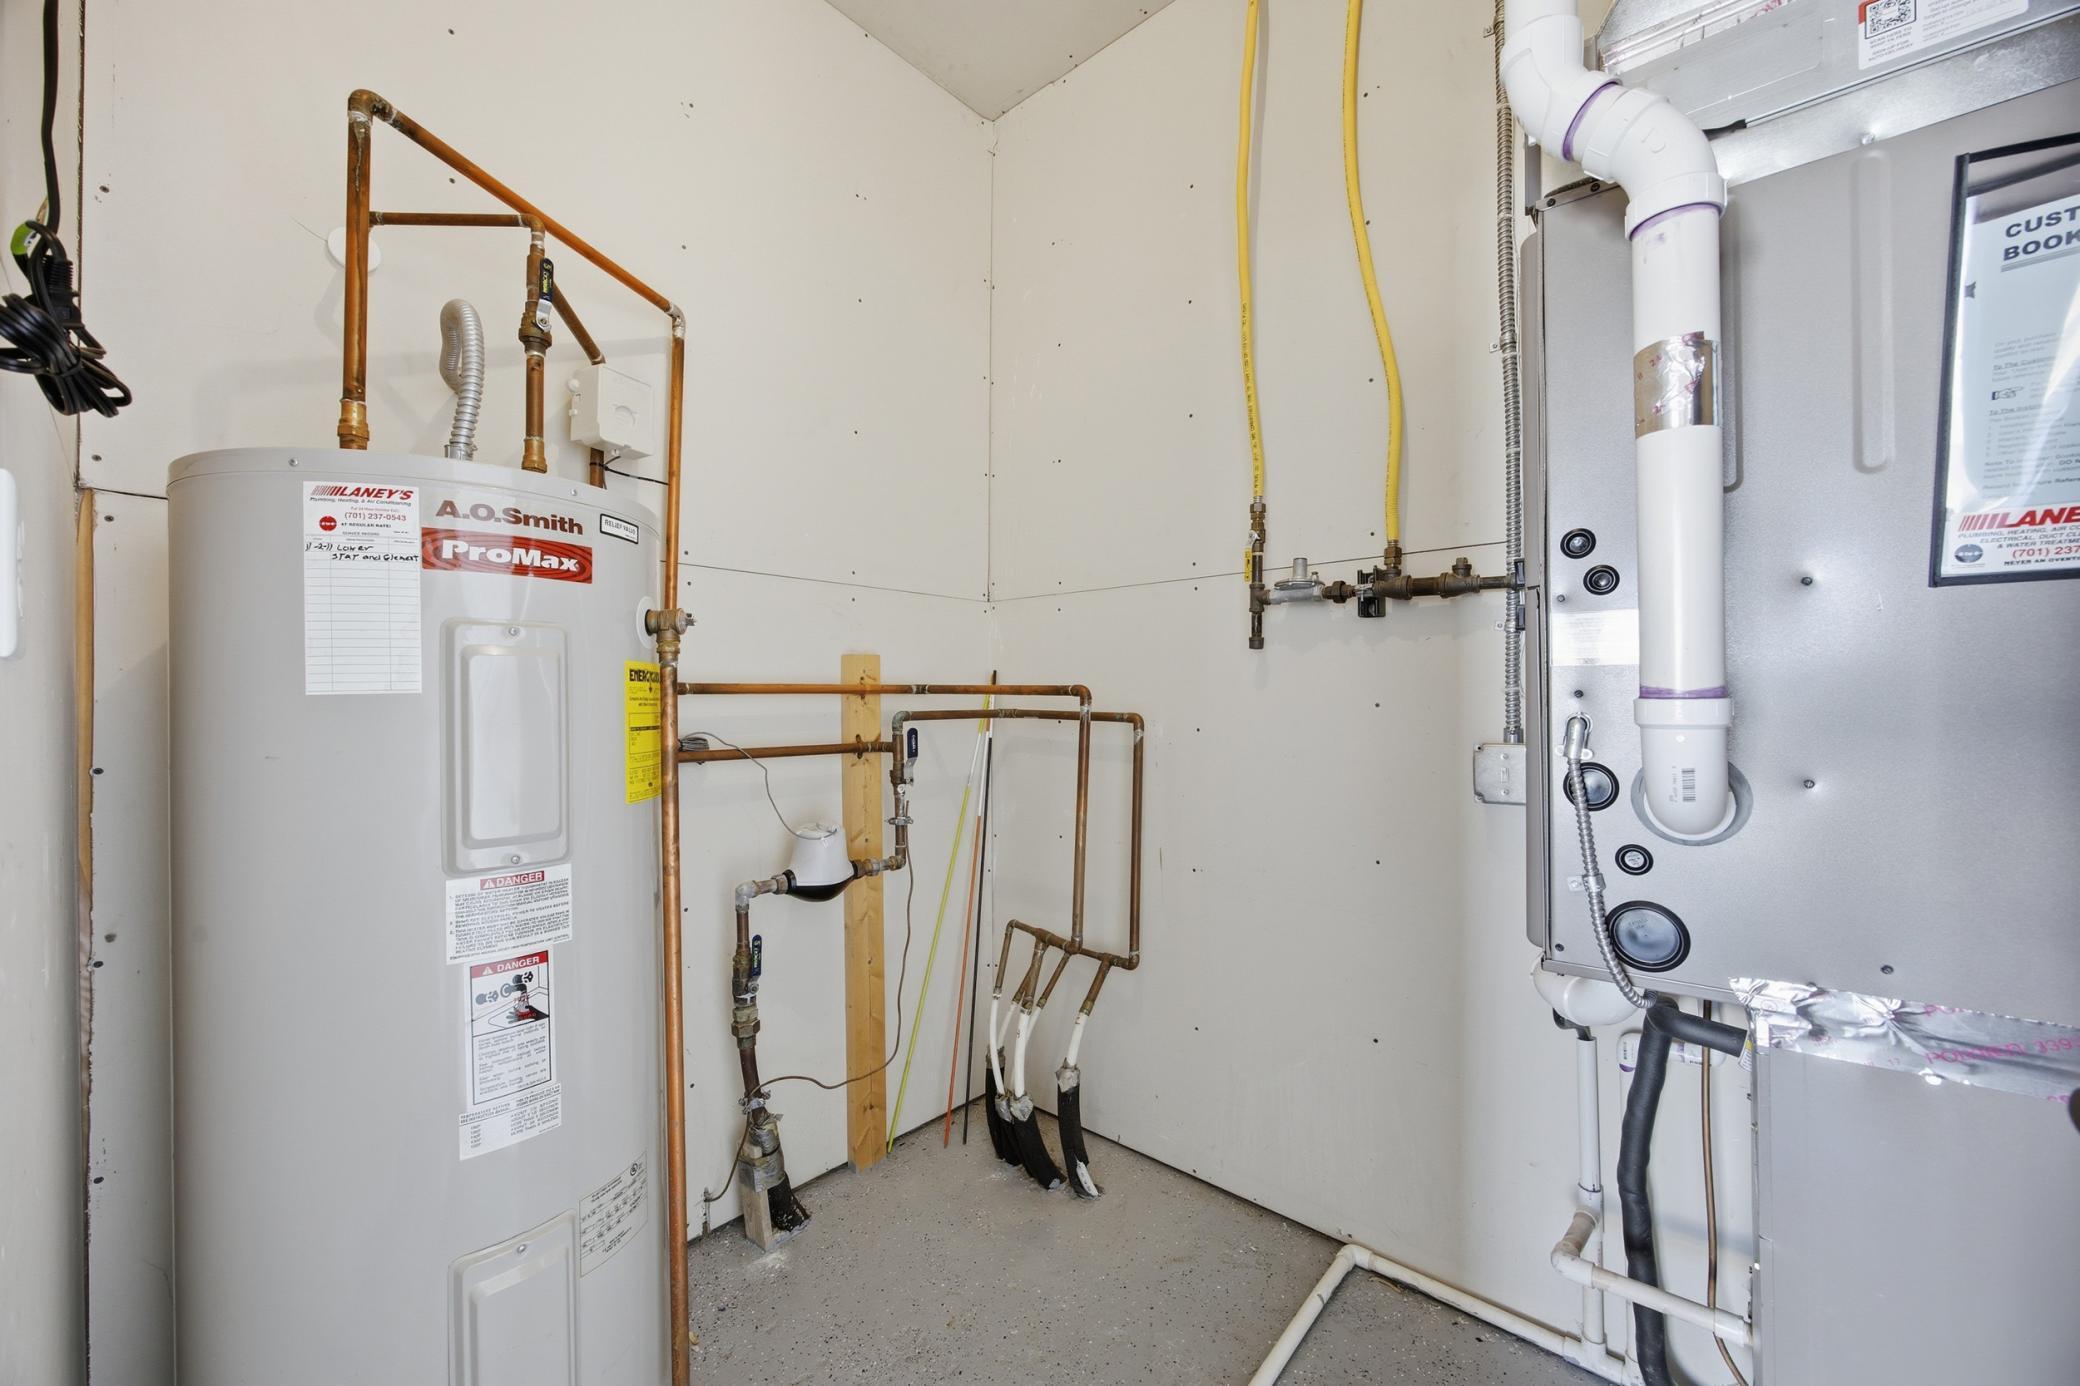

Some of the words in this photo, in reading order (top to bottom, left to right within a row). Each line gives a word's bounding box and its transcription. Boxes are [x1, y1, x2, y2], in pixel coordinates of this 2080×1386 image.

[2005, 205, 2080, 238] CUST
[339, 486, 414, 500] LANEY'S
[344, 511, 366, 520] (701)
[368, 512, 407, 521] 237-0543
[436, 500, 584, 535] A.O.Smith
[442, 539, 578, 572] ProMax
[2012, 547, 2050, 559] (701)
[496, 872, 543, 887] DANGER
[497, 956, 540, 973] DANGER
